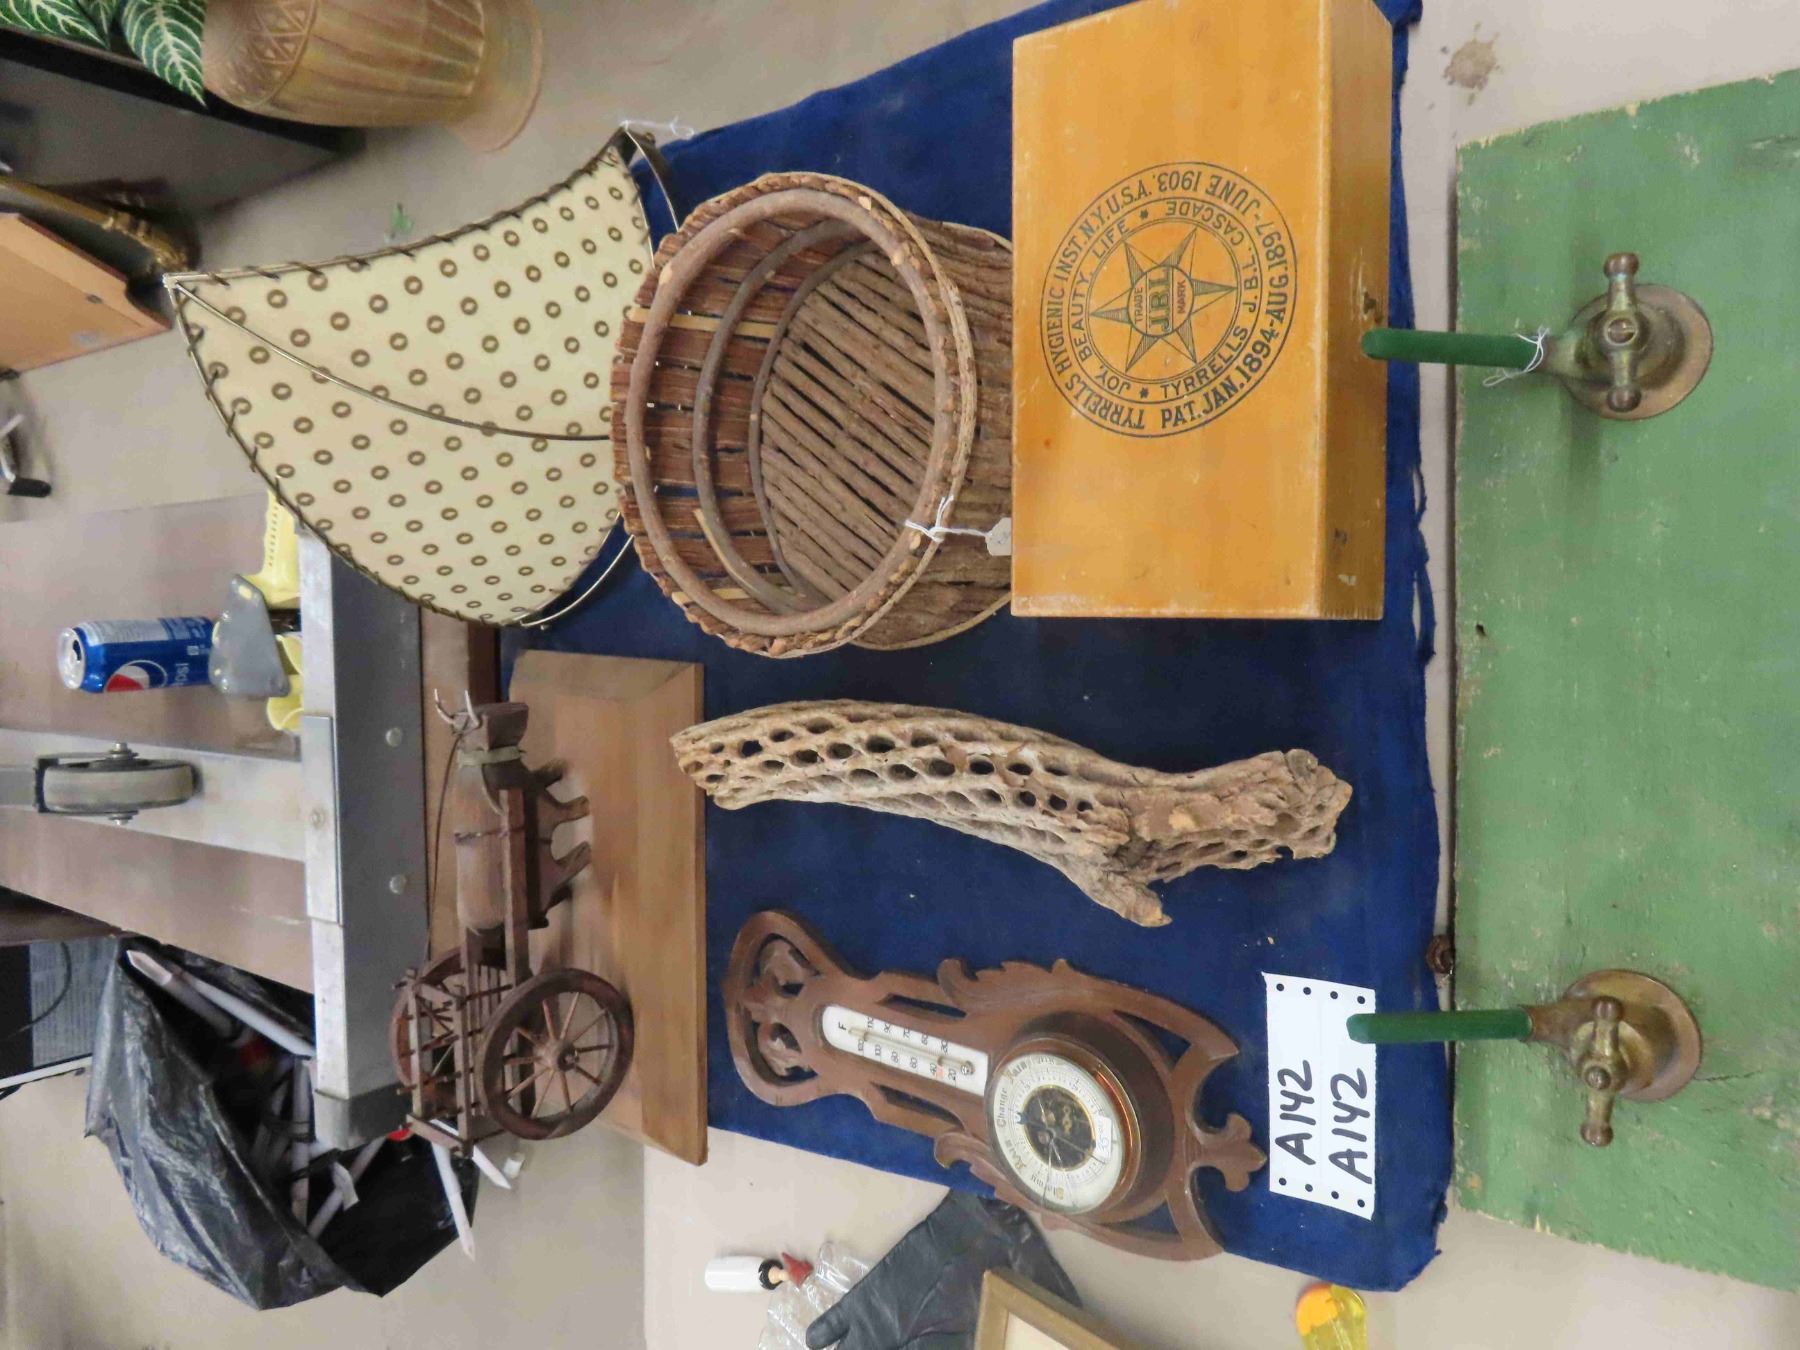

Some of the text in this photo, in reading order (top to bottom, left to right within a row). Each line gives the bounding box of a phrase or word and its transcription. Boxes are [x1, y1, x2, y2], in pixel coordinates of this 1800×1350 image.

[1091, 218, 1129, 260] LIFE
[1165, 200, 1246, 246] CASCADE
[1134, 287, 1143, 324] TRADE
[1176, 280, 1186, 314] MARK
[1046, 287, 1072, 376] HYGIENIC
[1160, 326, 1248, 398] TYRRELLS
[1064, 373, 1145, 430] TYRRELLS
[838, 1022, 846, 1030] F
[996, 1087, 1008, 1128] Change
[1274, 1060, 1316, 1166] A142
[1328, 1068, 1372, 1184] A142
